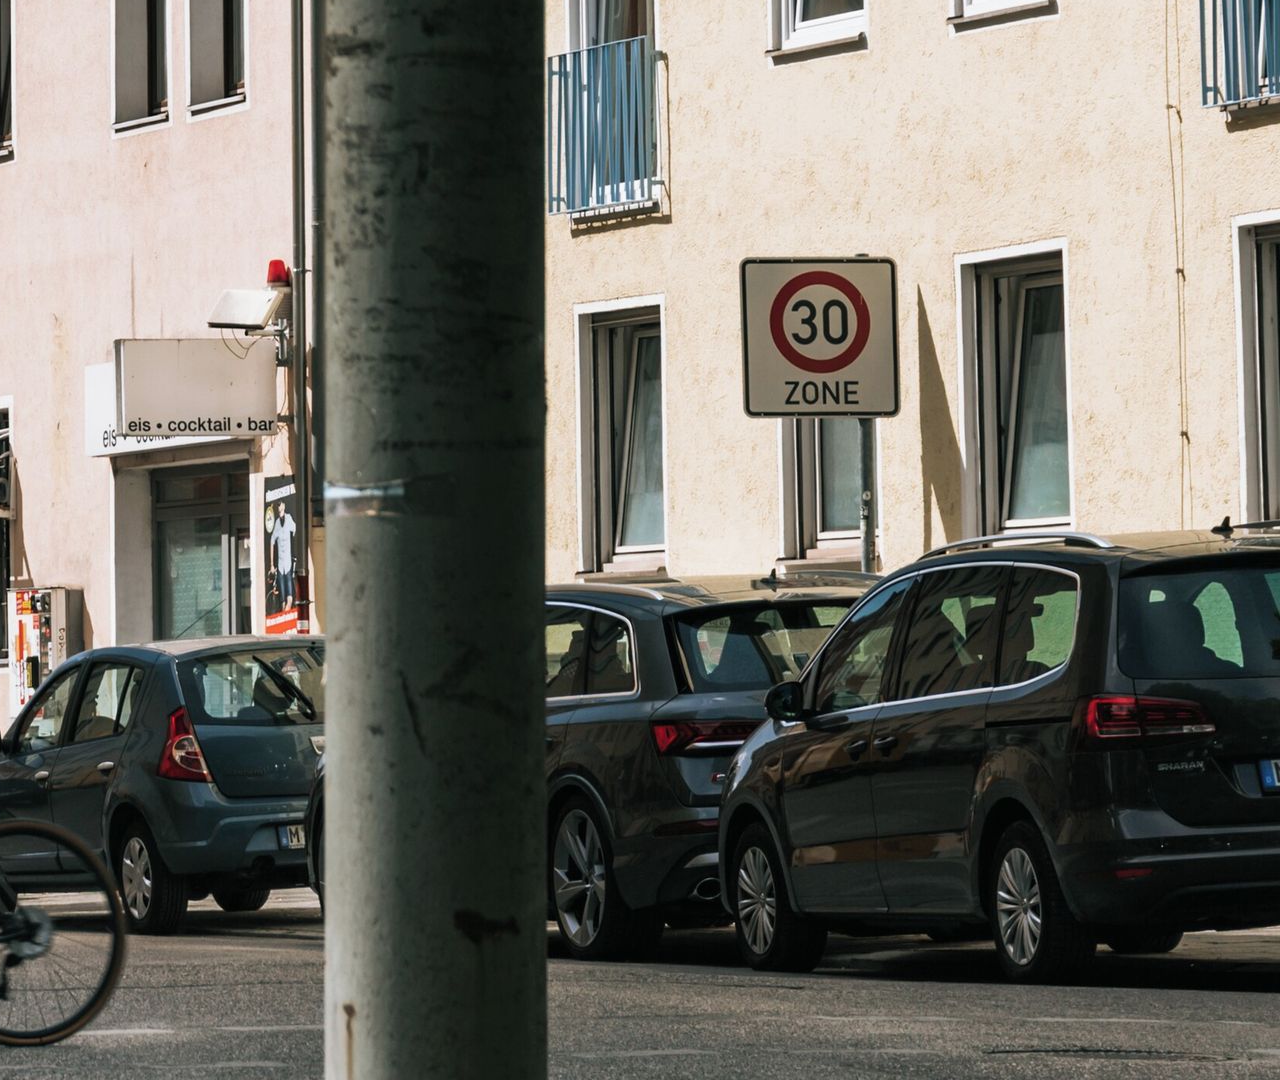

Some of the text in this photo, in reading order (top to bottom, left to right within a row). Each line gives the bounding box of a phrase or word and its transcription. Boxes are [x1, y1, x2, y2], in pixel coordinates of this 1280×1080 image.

[791, 299, 849, 346] 30
[784, 380, 860, 405] ZONE
[127, 417, 275, 432] eis cocktail bar
[1157, 760, 1204, 771] SHARAN
[288, 827, 301, 843] M
